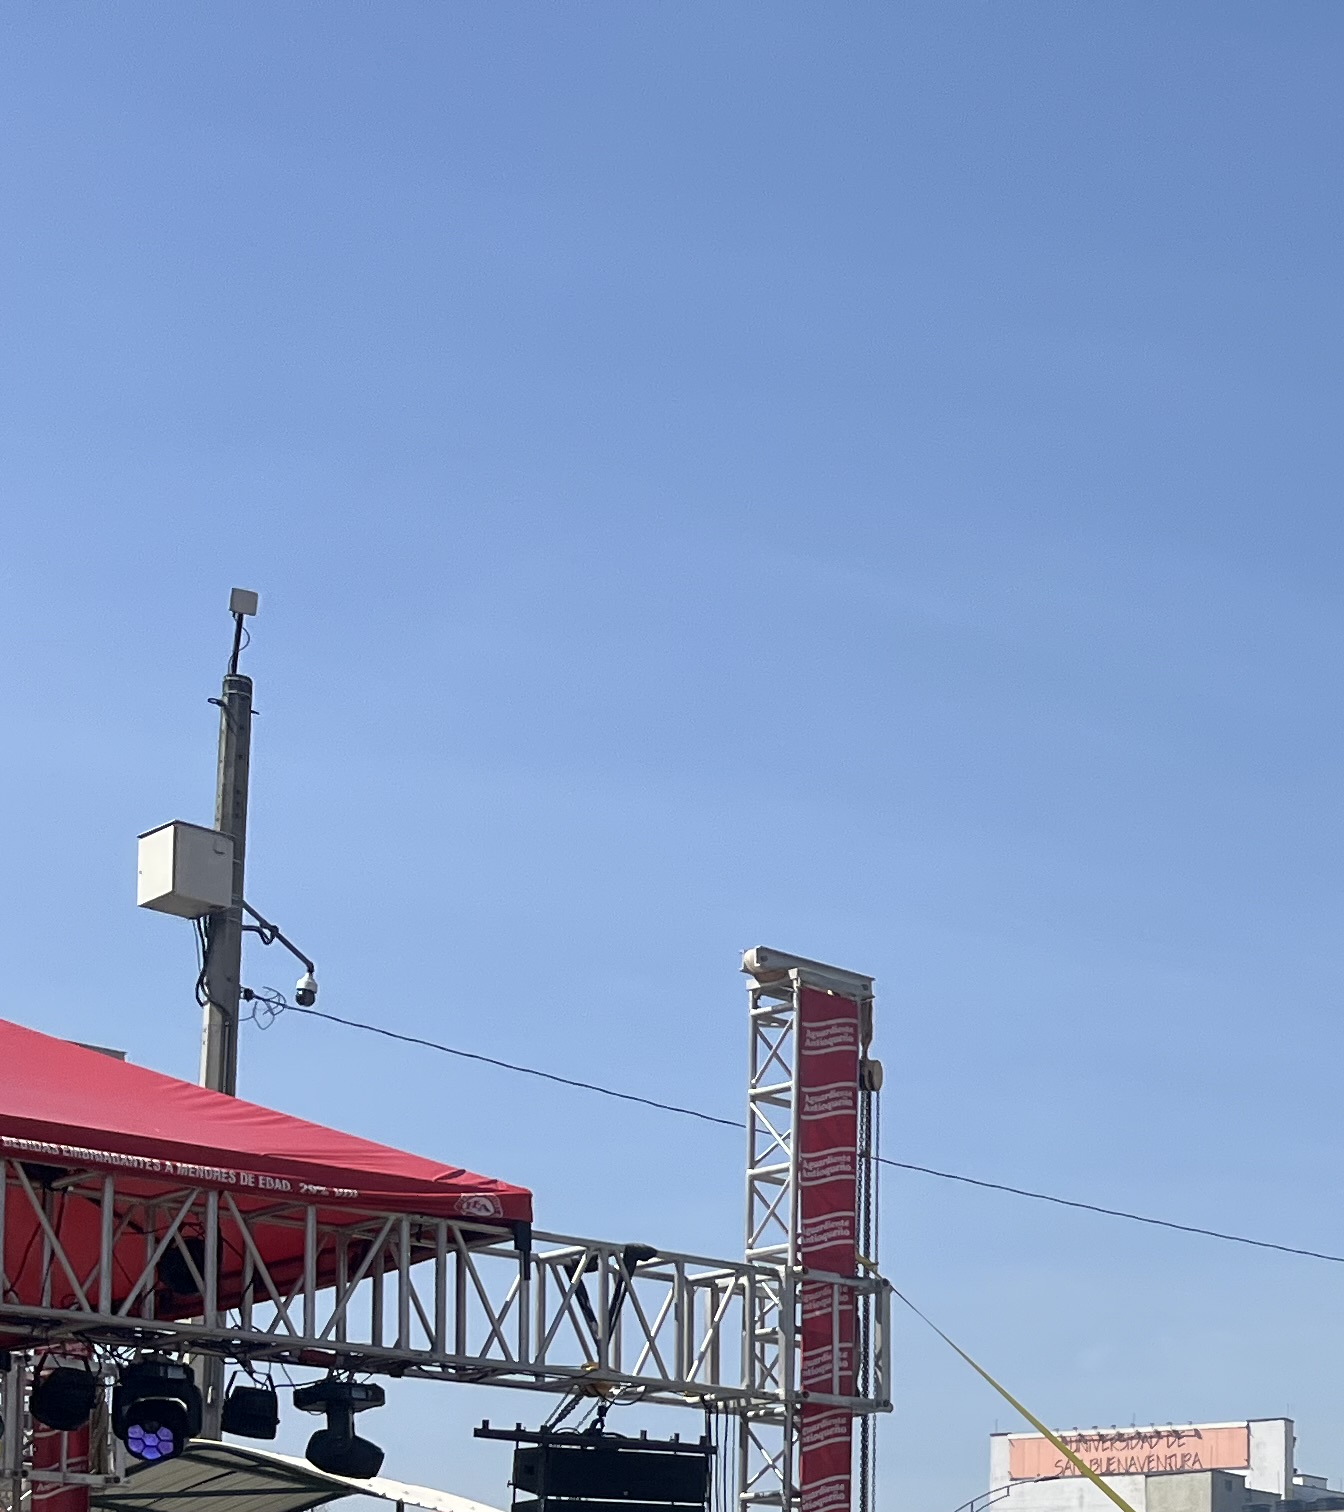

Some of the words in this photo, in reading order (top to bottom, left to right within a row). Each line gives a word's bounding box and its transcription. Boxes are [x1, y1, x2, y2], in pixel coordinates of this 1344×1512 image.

[176, 1162, 237, 1184] MENORES
[240, 1173, 255, 1187] DE
[1090, 1451, 1203, 1474] BUENAVENTURA
